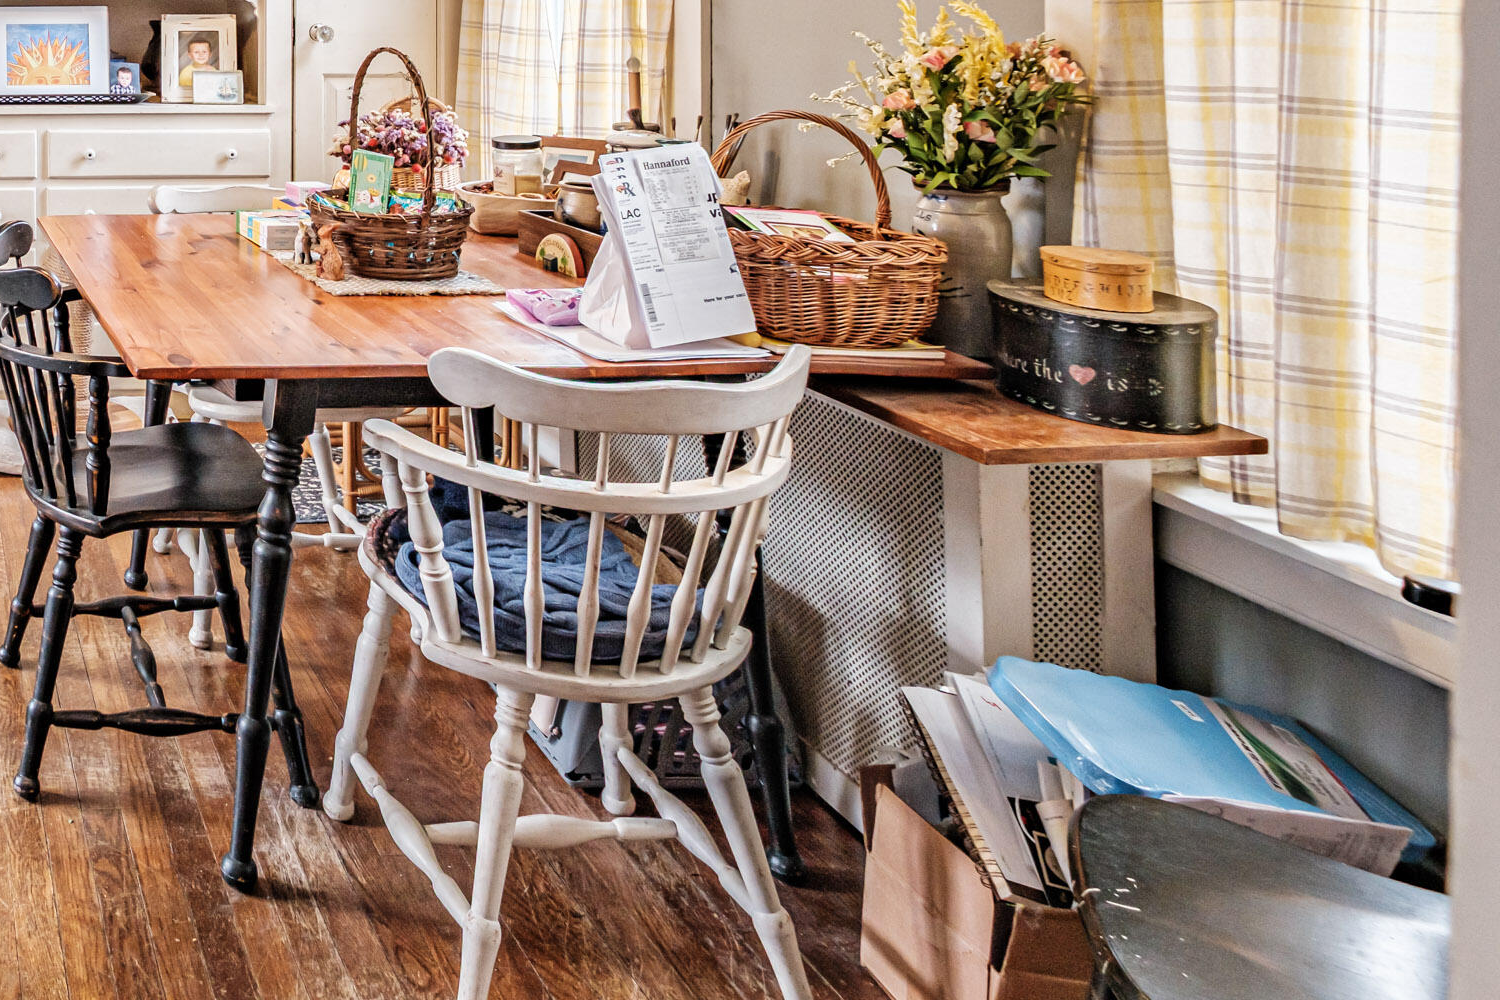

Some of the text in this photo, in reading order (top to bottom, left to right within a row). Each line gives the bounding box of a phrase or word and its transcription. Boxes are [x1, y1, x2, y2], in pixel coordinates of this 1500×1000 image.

[643, 157, 691, 171] Hannaford
[620, 208, 641, 220] LAC
[1033, 358, 1063, 383] the
[1105, 371, 1129, 392] is
